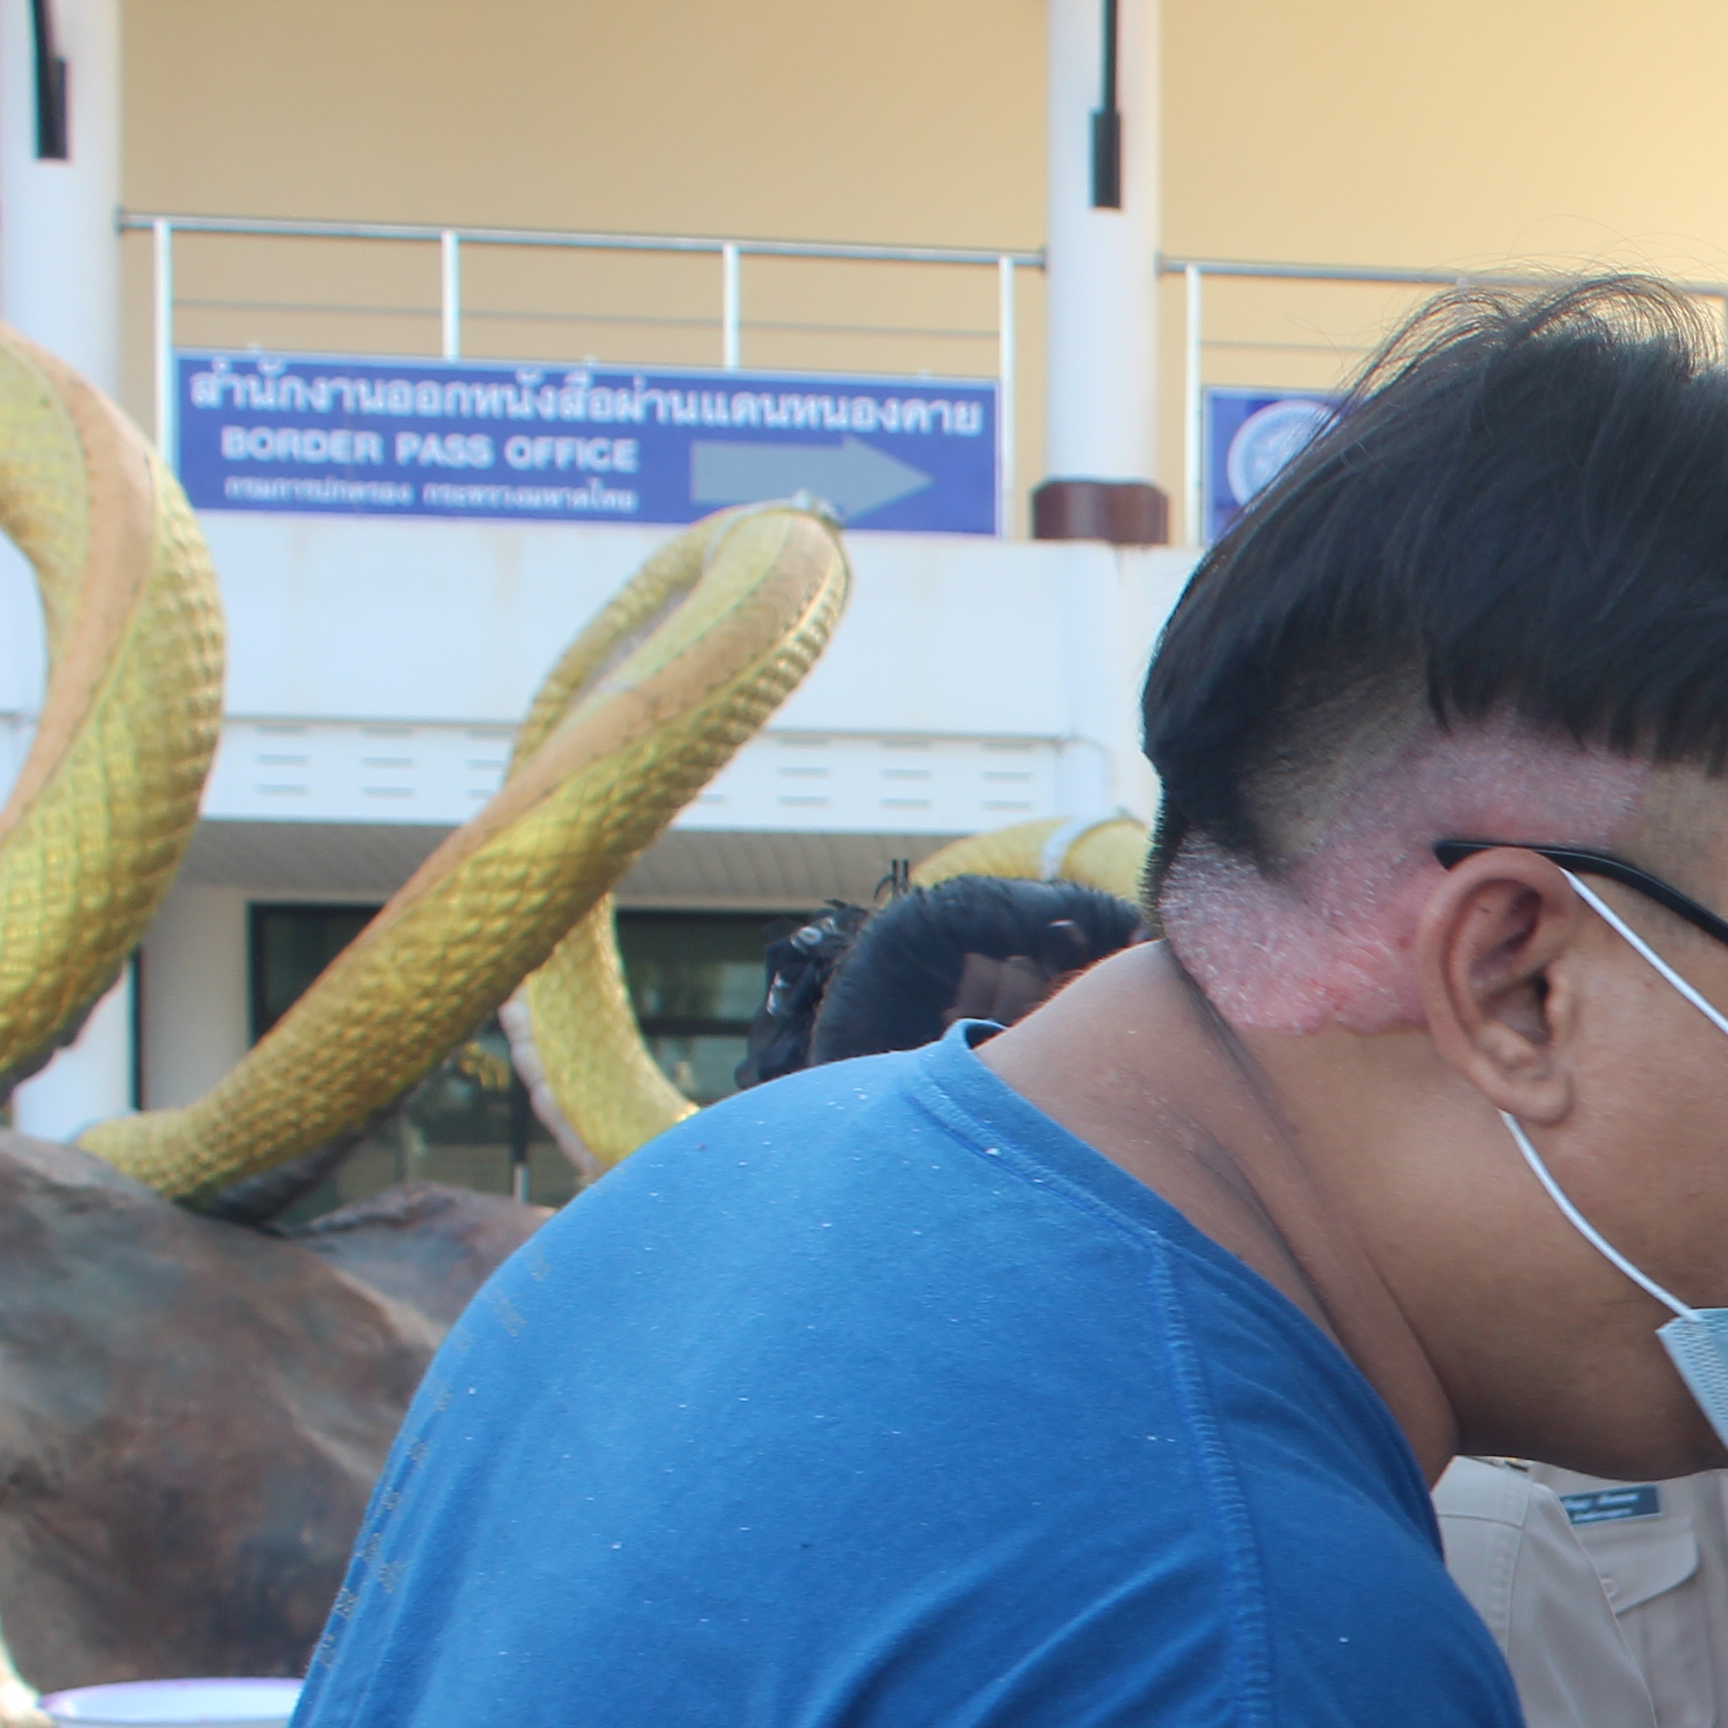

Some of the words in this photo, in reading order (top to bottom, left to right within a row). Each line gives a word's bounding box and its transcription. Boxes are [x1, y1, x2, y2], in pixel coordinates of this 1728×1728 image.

[221, 425, 385, 465] BORDER
[395, 431, 497, 469] PASS
[504, 434, 639, 474] OFFICE
